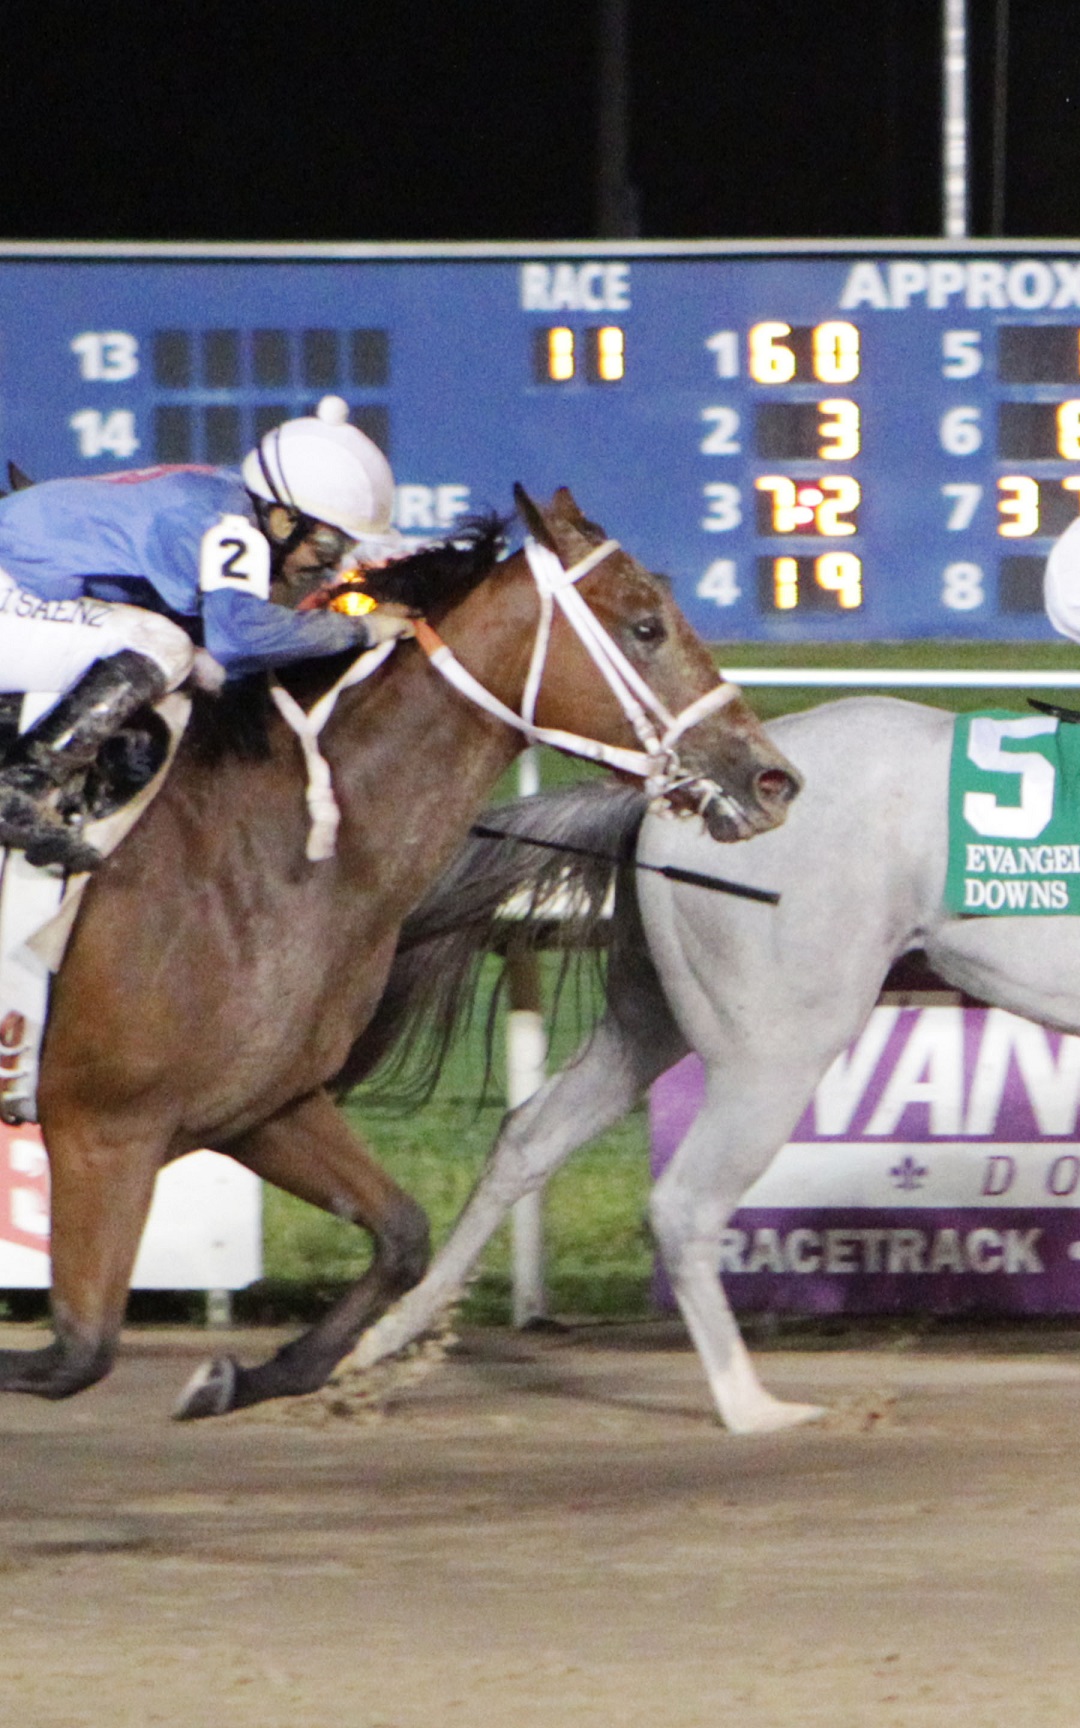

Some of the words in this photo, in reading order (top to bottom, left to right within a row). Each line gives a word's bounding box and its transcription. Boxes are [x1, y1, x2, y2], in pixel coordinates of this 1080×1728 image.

[522, 262, 632, 311] RACE
[70, 331, 139, 382] 13
[705, 330, 740, 379] 1
[941, 330, 983, 380] 5
[70, 408, 140, 459] 14
[701, 406, 742, 456] 2
[818, 398, 861, 460] 3
[940, 407, 983, 456] 6
[702, 483, 743, 532] 3
[942, 483, 983, 531] 7
[218, 537, 250, 580] 2
[697, 558, 743, 607] 4
[16, 591, 115, 627] SAENZ
[942, 562, 984, 611] 8
[962, 716, 1060, 840] 5
[964, 878, 1070, 910] DOWNS
[718, 1227, 1045, 1274] RACETRACK
